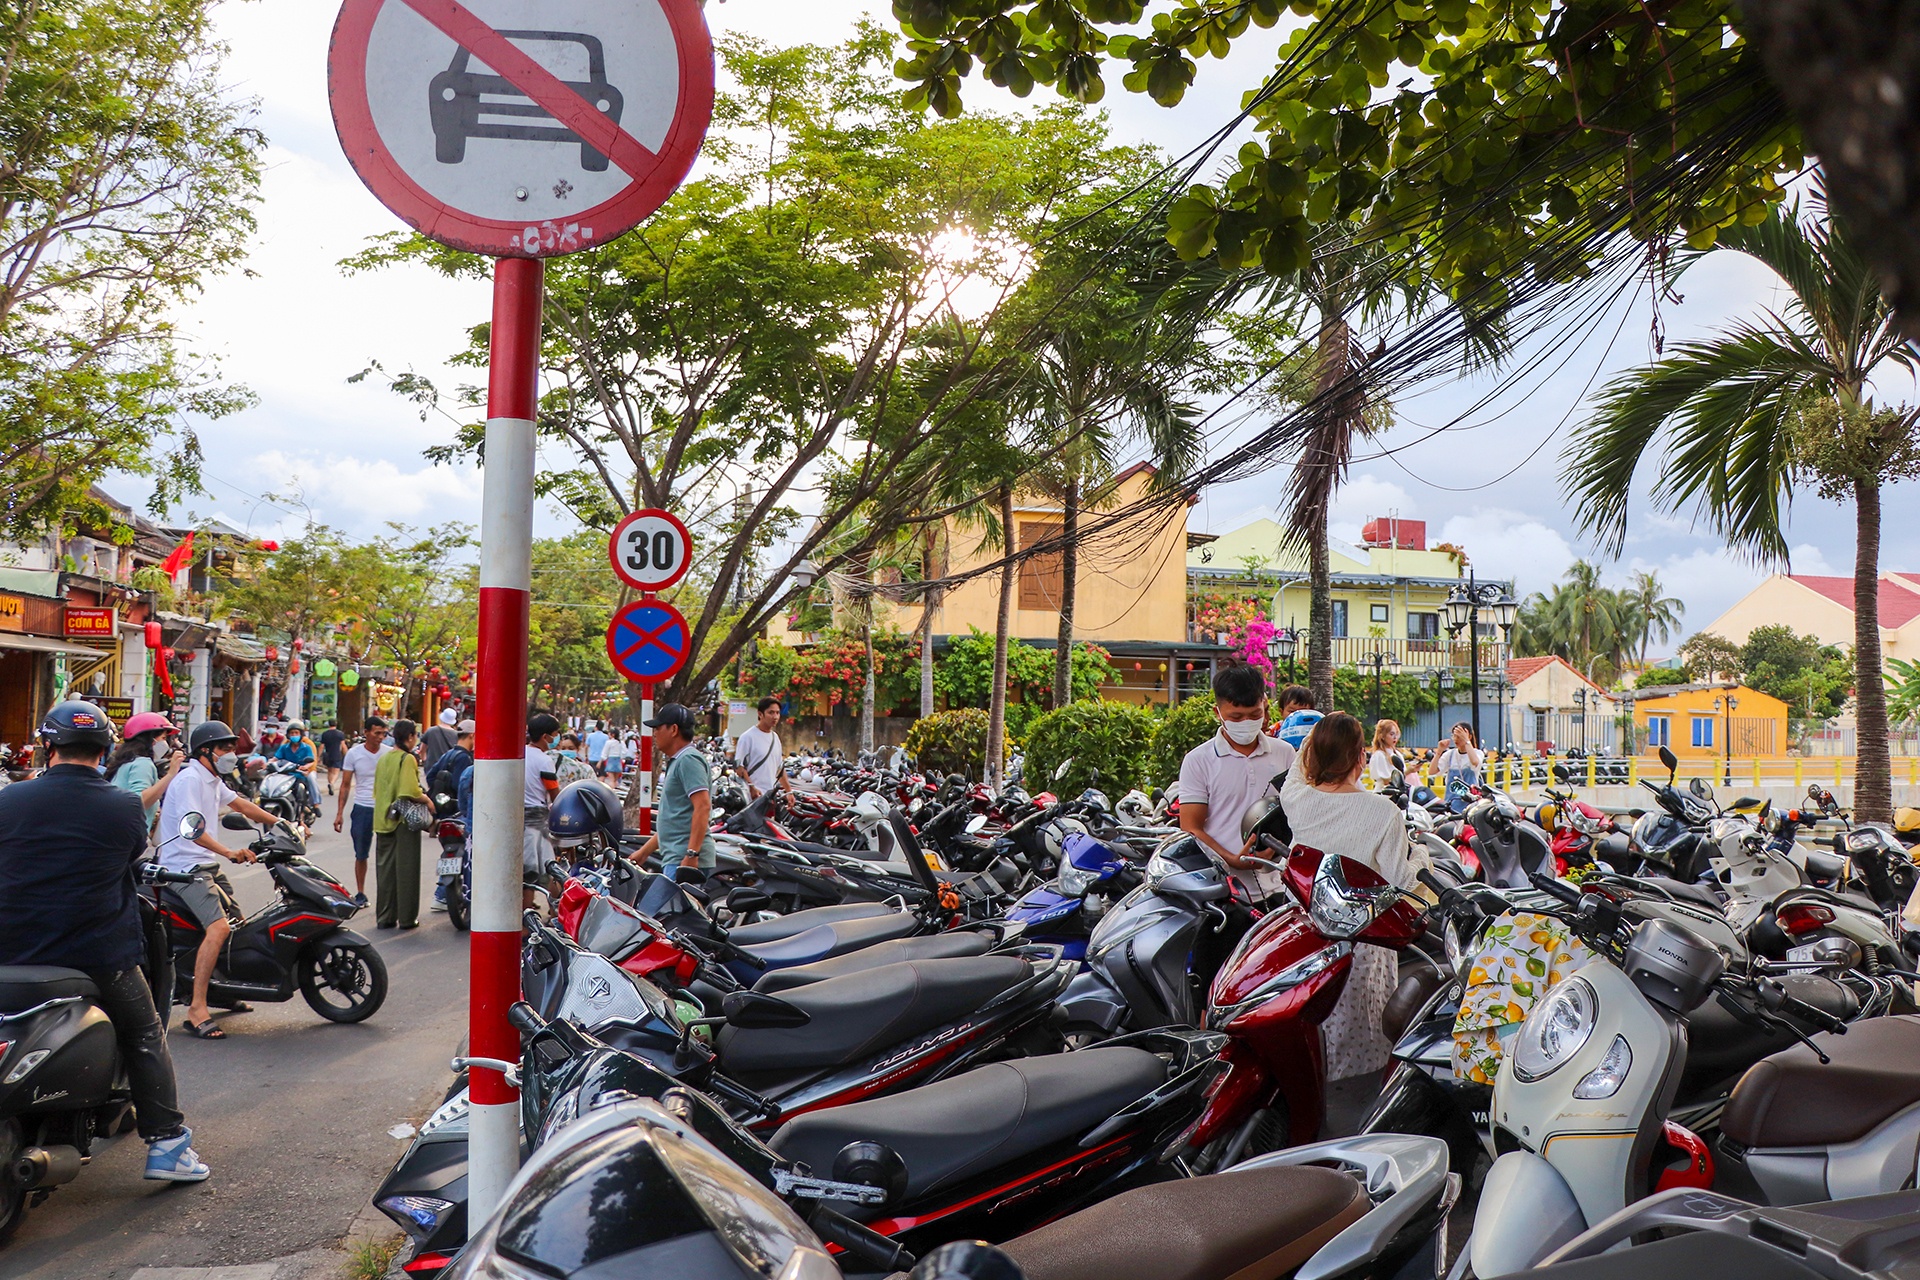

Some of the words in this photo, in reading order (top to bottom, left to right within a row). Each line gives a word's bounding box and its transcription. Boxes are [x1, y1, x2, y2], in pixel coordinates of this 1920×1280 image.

[627, 531, 674, 570] 30
[68, 617, 92, 628] CƠM
[95, 616, 109, 628] GÀ
[1040, 909, 1069, 920] 150
[1658, 946, 1689, 967] HONDA
[1555, 1110, 1628, 1121] prestige
